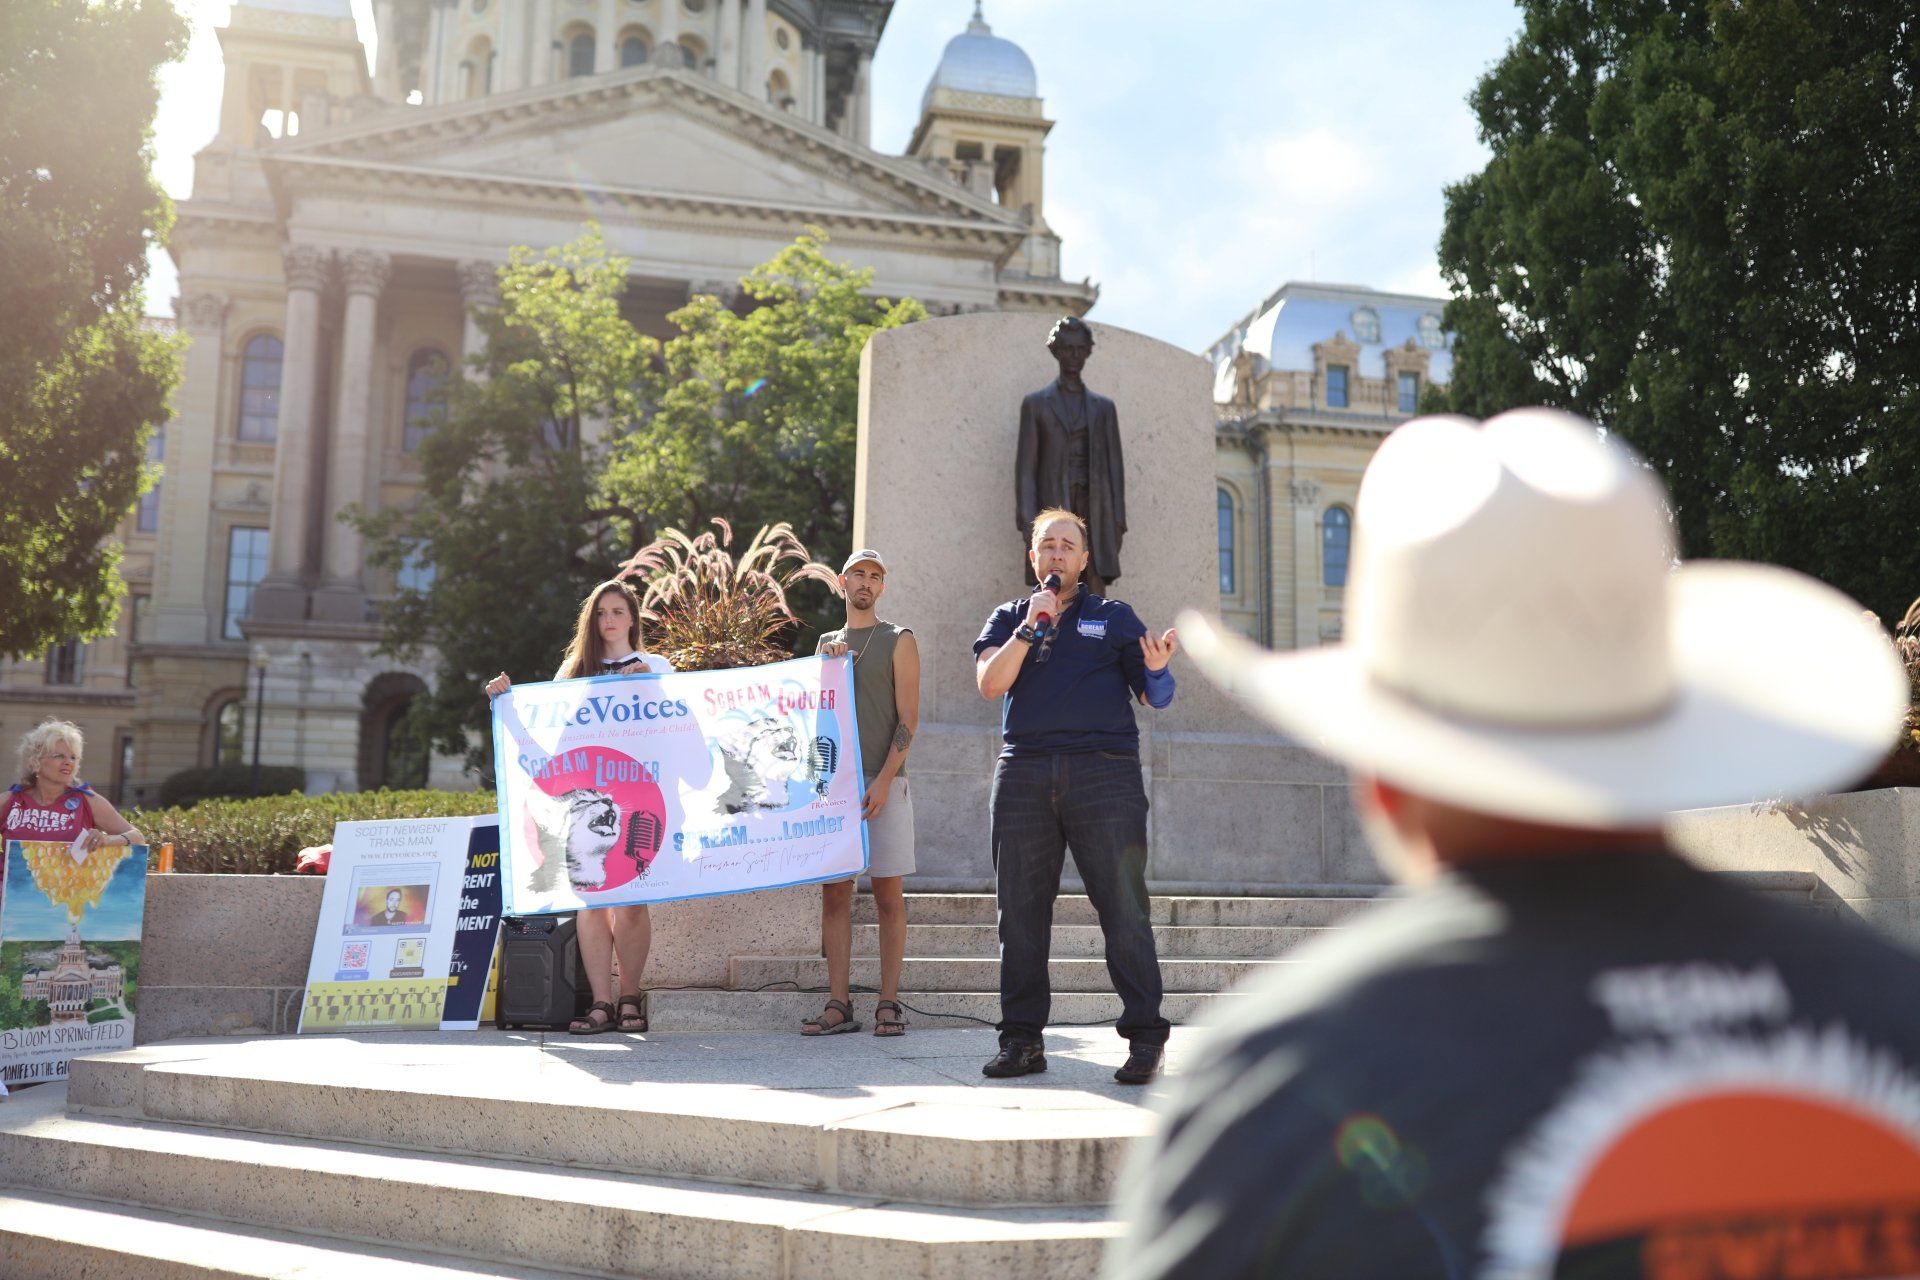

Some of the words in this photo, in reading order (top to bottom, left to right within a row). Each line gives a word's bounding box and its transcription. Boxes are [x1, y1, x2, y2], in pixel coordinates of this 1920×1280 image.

[704, 684, 771, 717] SCREAM
[777, 688, 835, 716] LOUDER
[524, 695, 688, 729] TReVoices
[518, 751, 589, 780] SCREAM
[595, 755, 661, 787] LOUDER
[354, 826, 391, 837] SCOTT
[394, 824, 448, 835] NEWGENT
[369, 837, 405, 848] TRANS
[407, 836, 434, 847] MAN
[471, 853, 499, 868] NOT
[463, 873, 495, 888] RENT
[1, 1029, 51, 1050] BLOOM
[54, 1023, 125, 1044] SPRINGFIELD
[41, 1061, 55, 1077] THE
